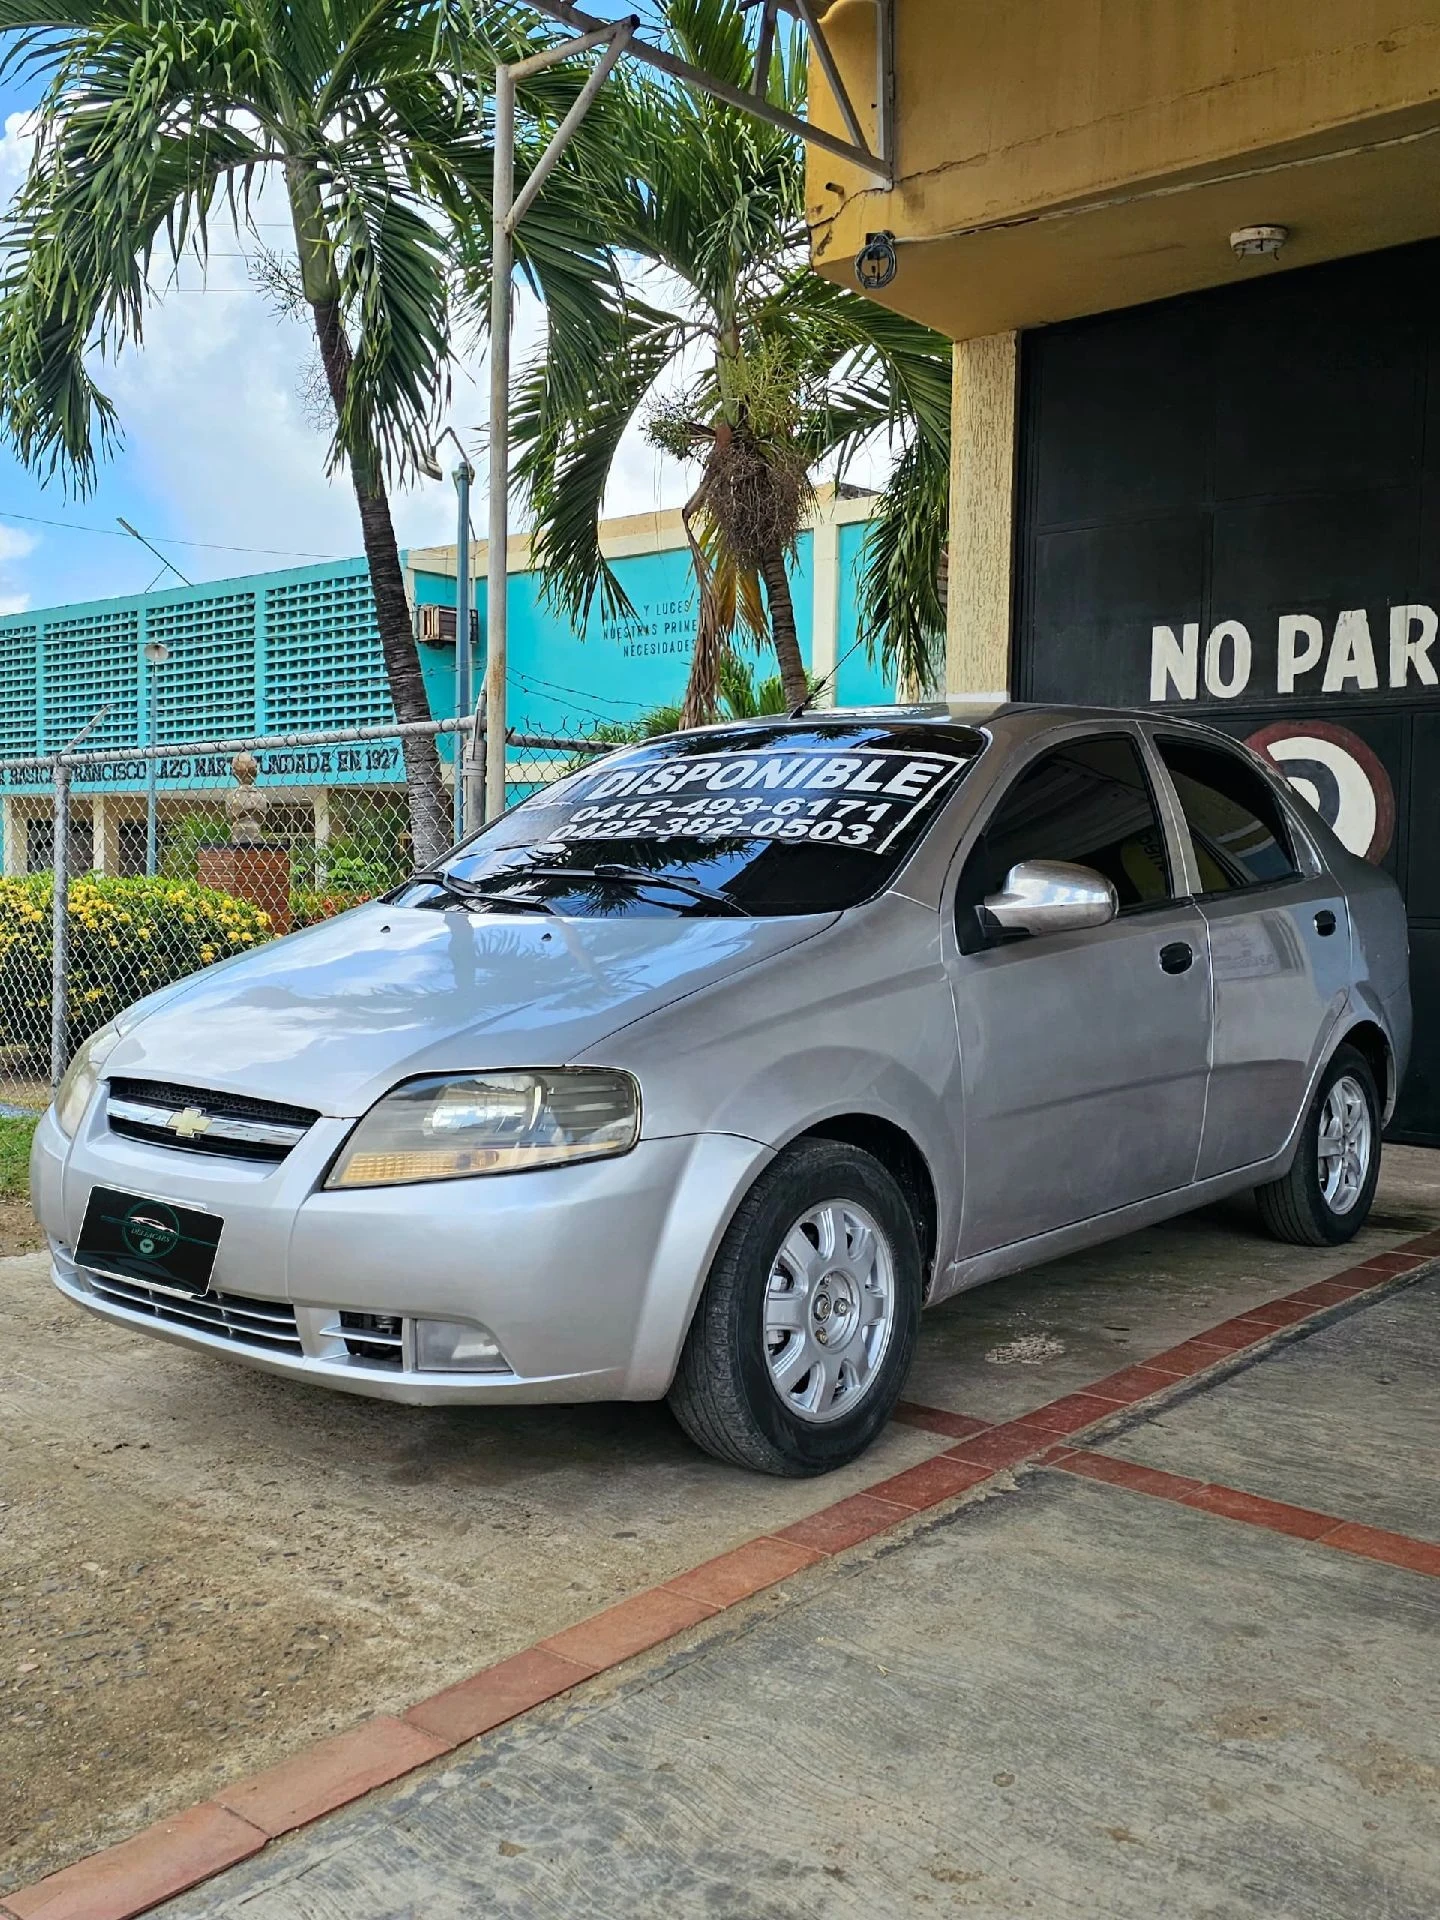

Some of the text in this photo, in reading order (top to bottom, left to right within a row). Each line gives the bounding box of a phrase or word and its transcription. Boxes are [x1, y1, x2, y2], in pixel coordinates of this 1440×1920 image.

[643, 605, 650, 616] Y
[656, 600, 690, 615] LUCES
[665, 619, 698, 635] PRIME
[1150, 604, 1440, 701] NO PAR
[71, 760, 147, 783] RANCISCO
[194, 756, 235, 777] MART
[254, 752, 332, 775] UNDADA
[337, 749, 361, 772] EN
[365, 747, 399, 771] 1927
[584, 757, 945, 801] DISPONIBLE
[569, 797, 892, 823] 0412-493-6171
[547, 817, 875, 845] 0422-382-0503
